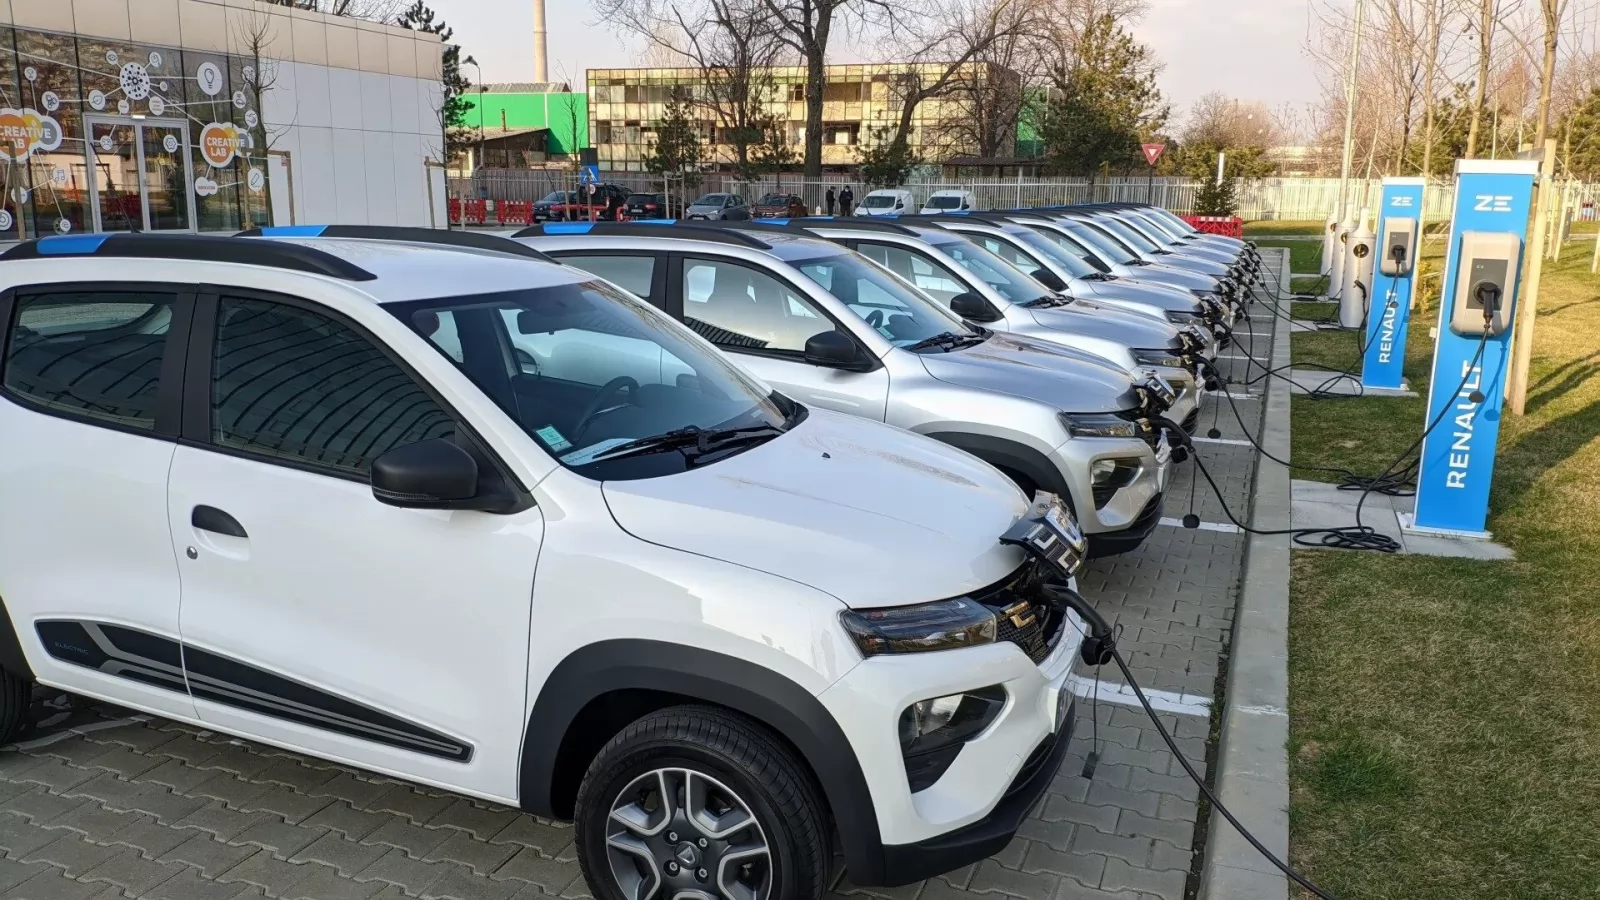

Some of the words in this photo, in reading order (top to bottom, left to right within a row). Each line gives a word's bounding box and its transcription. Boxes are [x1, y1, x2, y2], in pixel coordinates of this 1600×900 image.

[206, 137, 246, 148] CREATIVE
[210, 147, 227, 157] LAB
[1390, 196, 1413, 207] ZE
[1474, 195, 1513, 212] ZE
